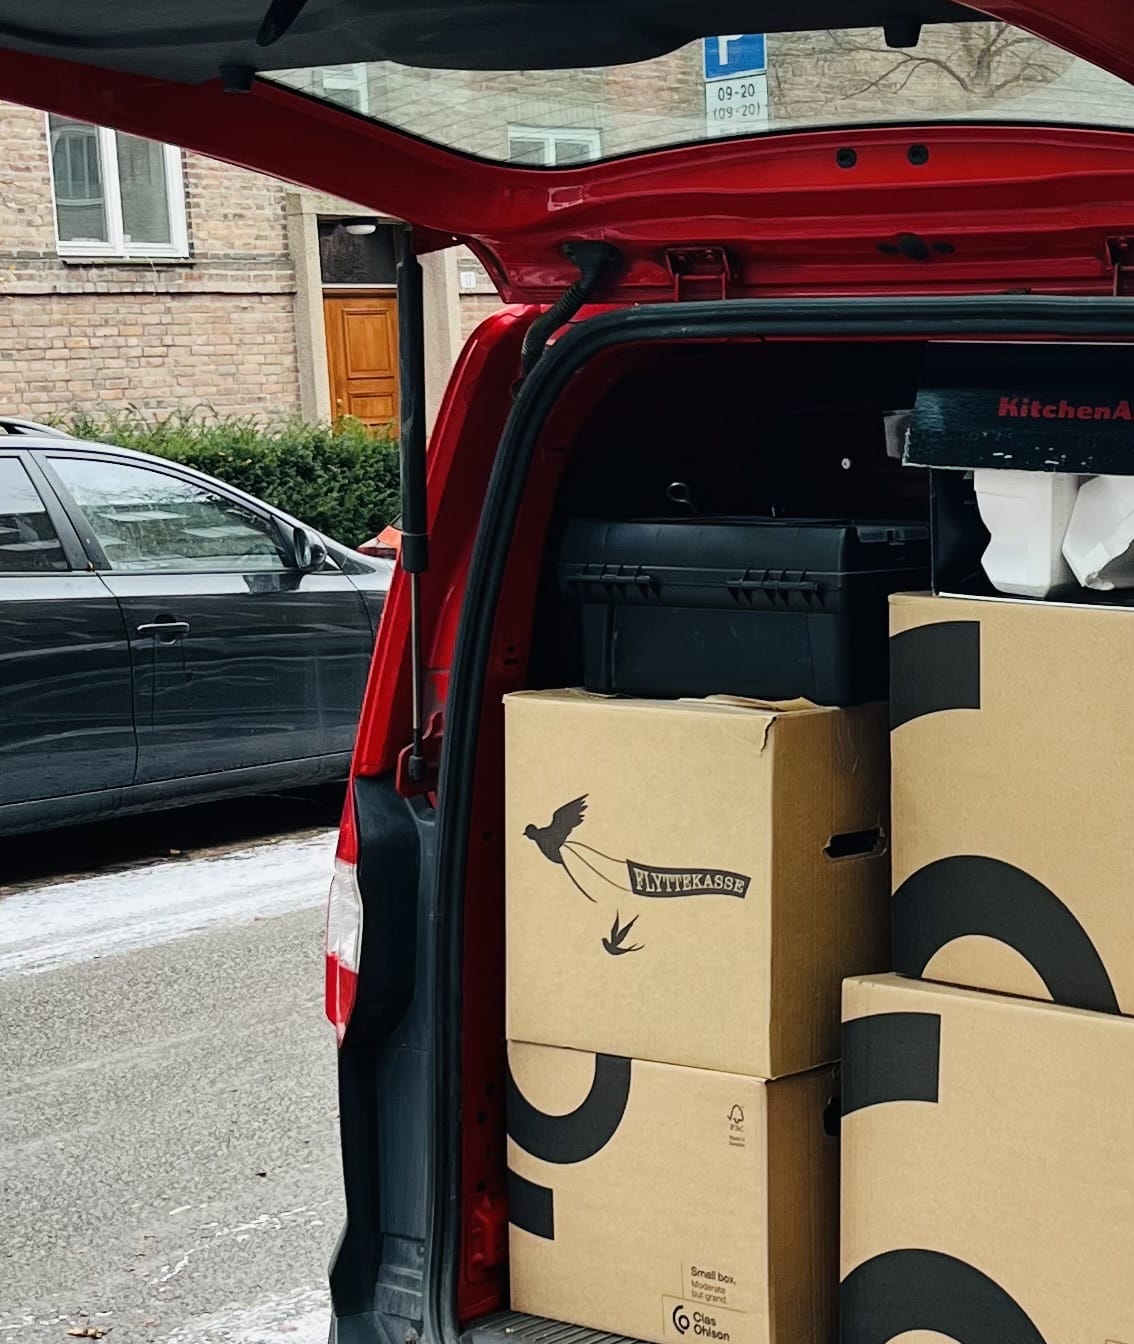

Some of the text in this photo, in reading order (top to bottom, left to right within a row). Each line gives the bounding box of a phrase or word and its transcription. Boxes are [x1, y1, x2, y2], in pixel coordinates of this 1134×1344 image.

[718, 83, 756, 101] 09-20
[713, 102, 761, 120] (09-20)
[632, 867, 745, 893] FLYTTEKASSE
[691, 1266, 736, 1285] Small box.
[693, 1311, 717, 1327] Clas
[693, 1323, 730, 1342] Ohlson
